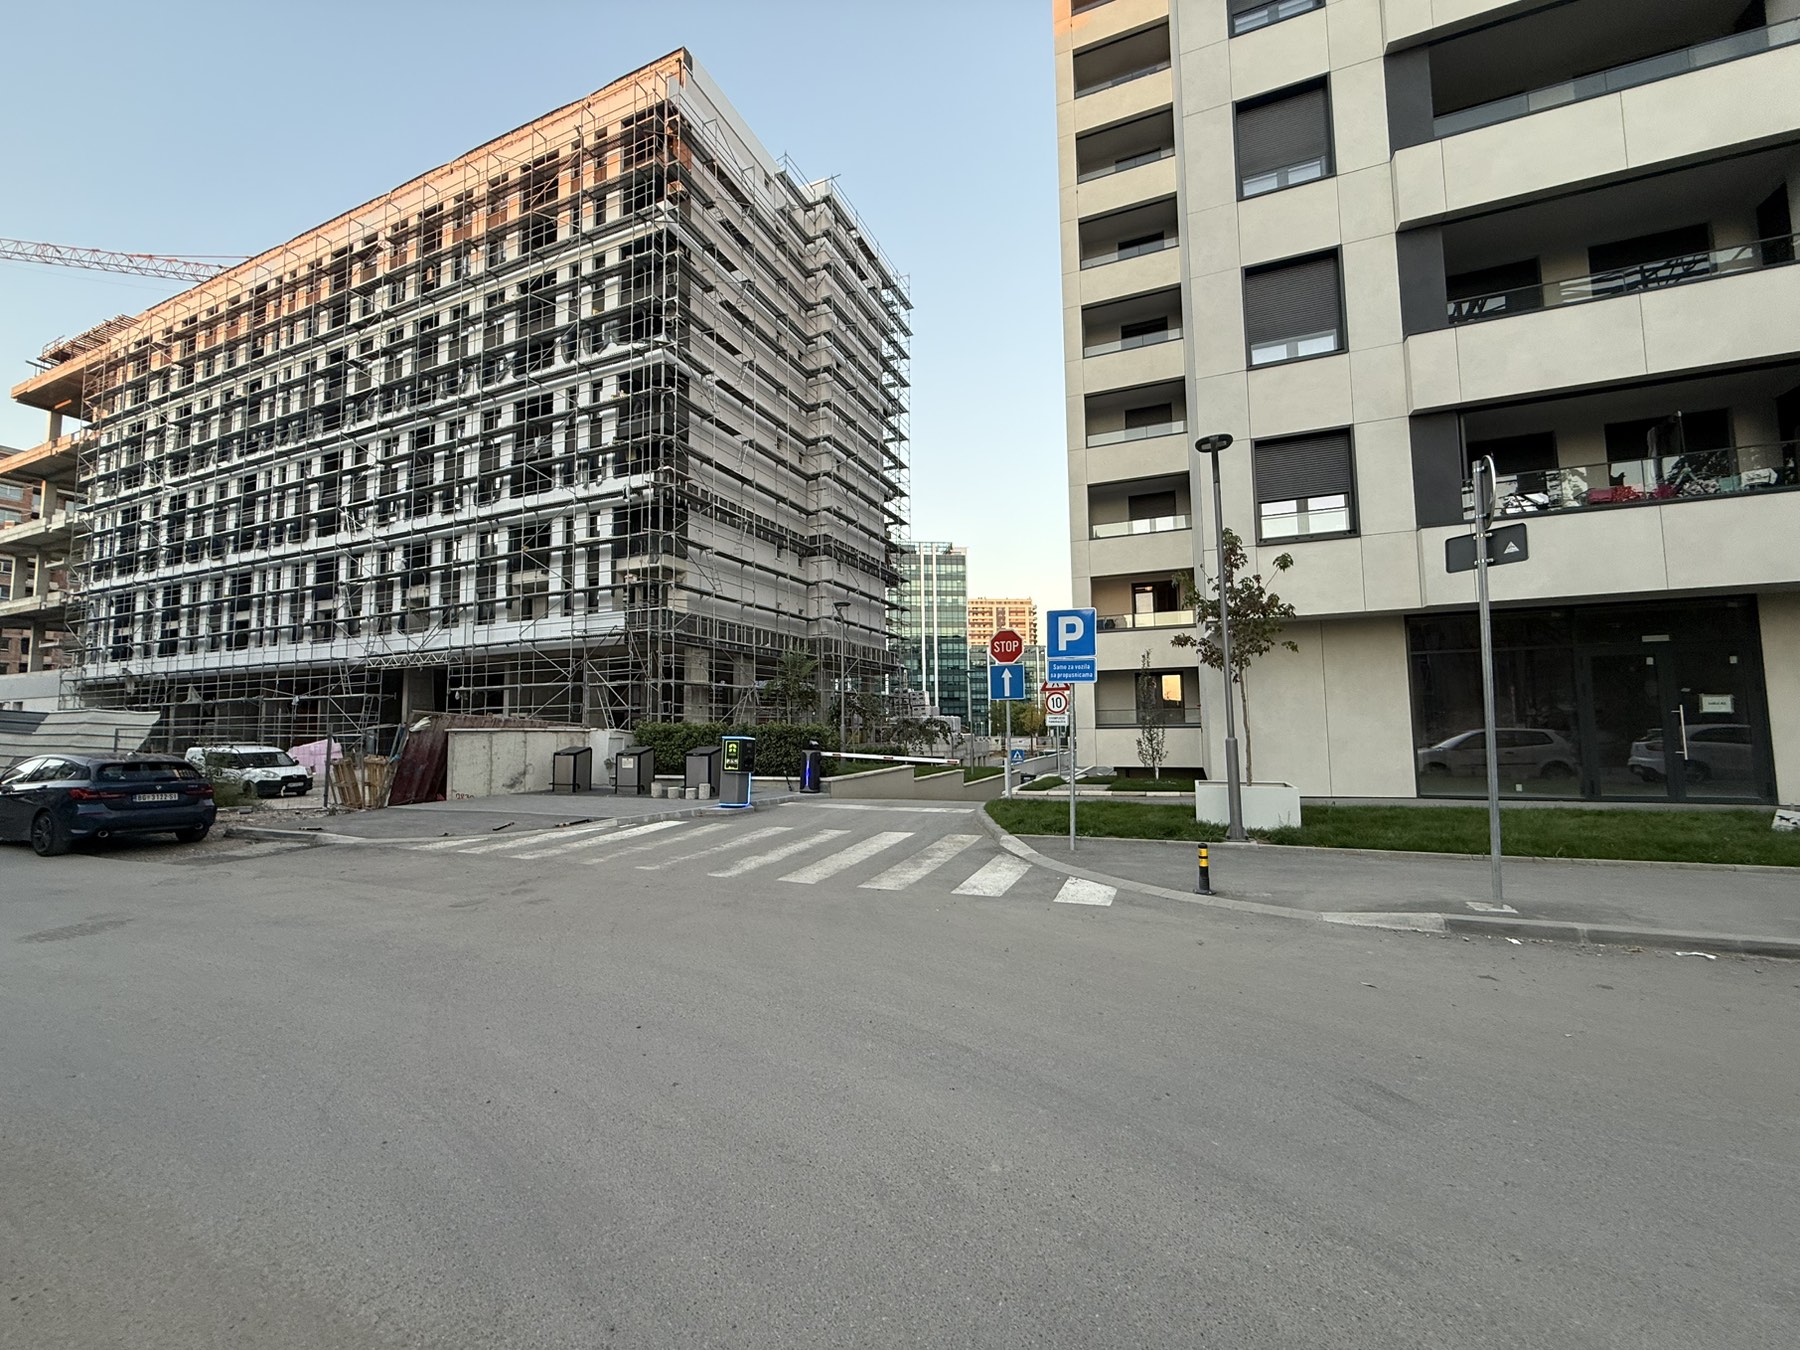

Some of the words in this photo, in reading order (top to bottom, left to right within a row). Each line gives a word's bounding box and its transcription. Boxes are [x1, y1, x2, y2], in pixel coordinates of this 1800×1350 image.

[1058, 615, 1084, 651] P
[993, 640, 1019, 653] STOP
[1051, 696, 1062, 709] 10
